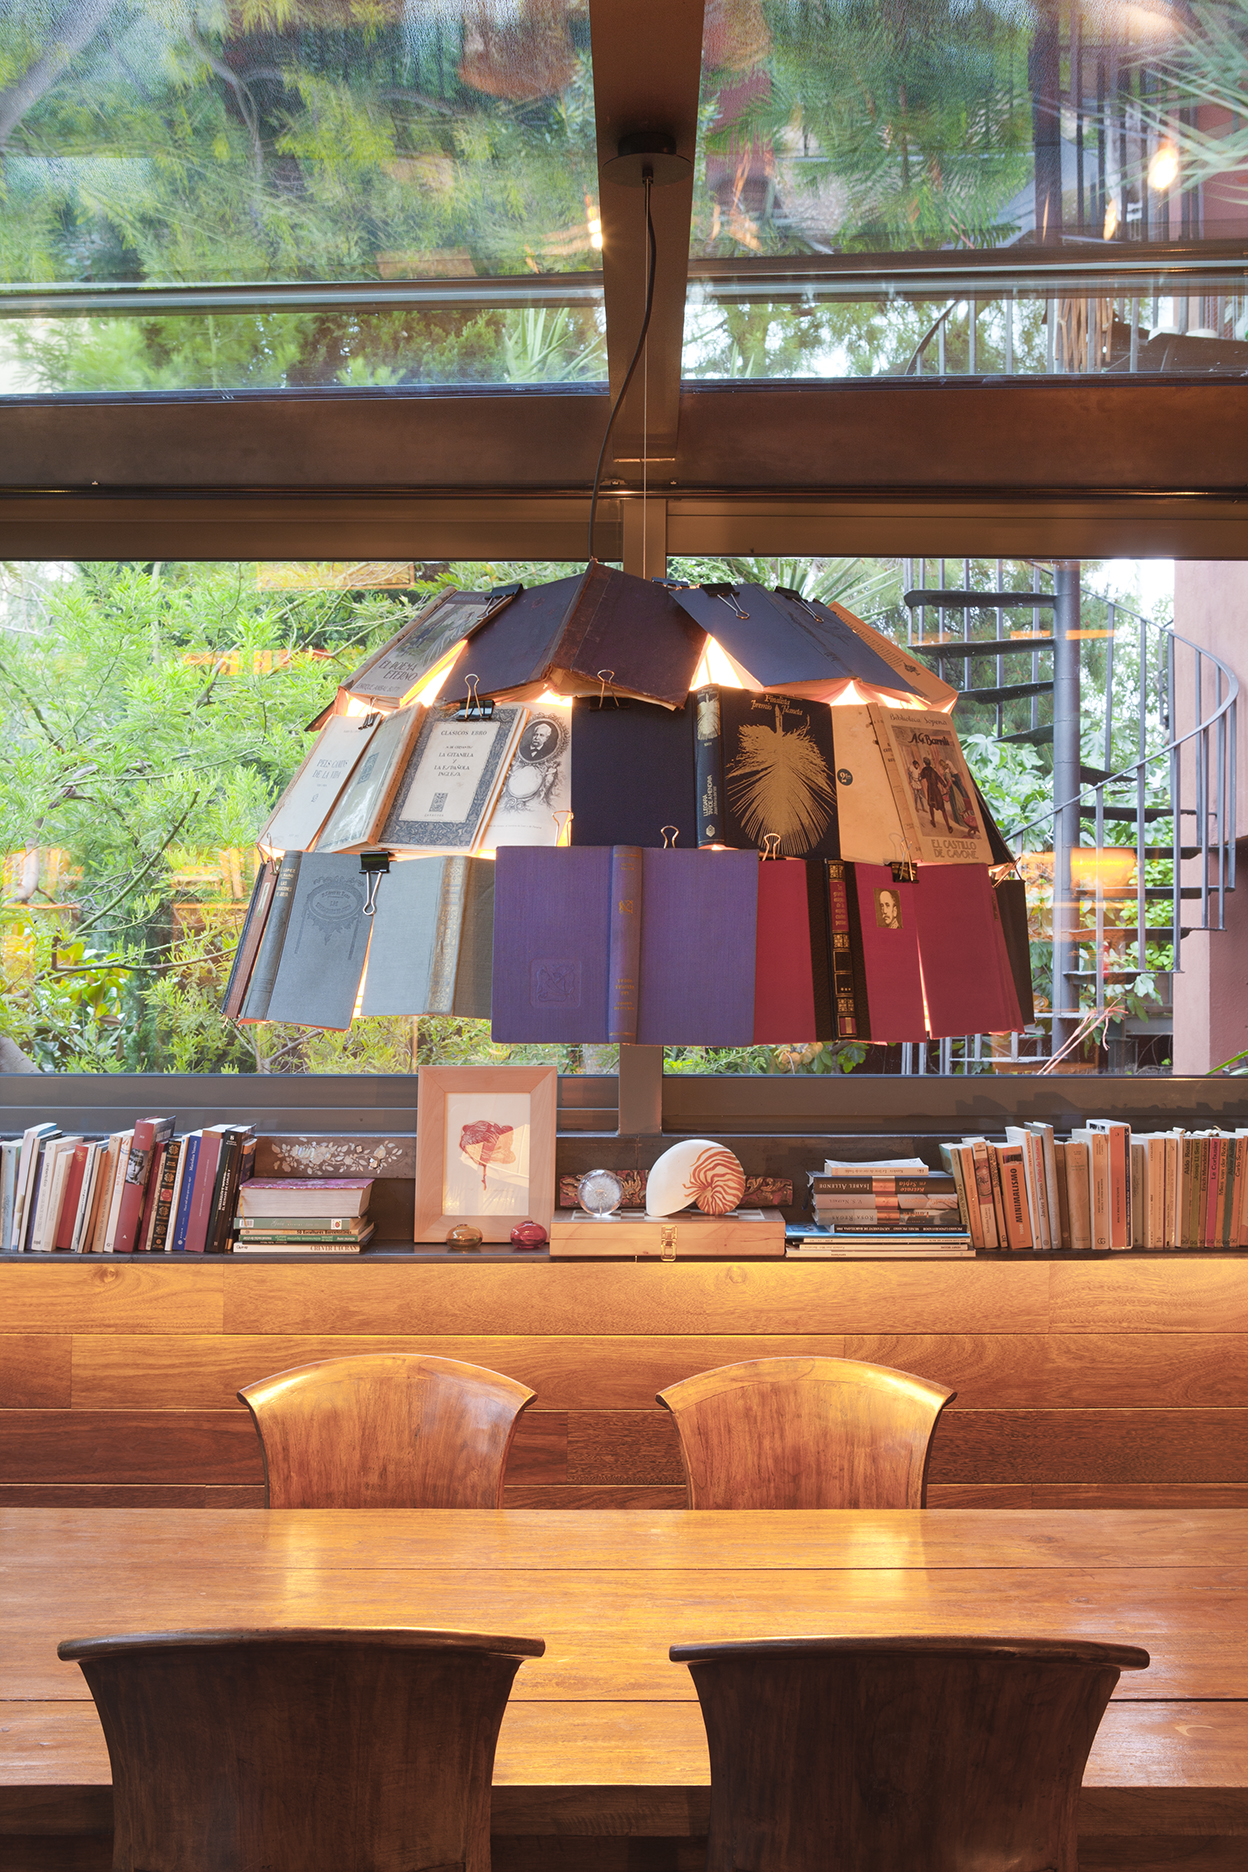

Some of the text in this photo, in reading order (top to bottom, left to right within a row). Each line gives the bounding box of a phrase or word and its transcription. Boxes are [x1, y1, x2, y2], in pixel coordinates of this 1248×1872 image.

[378, 660, 418, 671] EL POEMA
[383, 670, 418, 681] ETERNO
[890, 713, 947, 727] Biblioteca Sopena
[931, 839, 977, 850] EL CASTILLO
[933, 848, 945, 858] DE
[1032, 1139, 1046, 1218] Javier Tomeo Patio de butacas
[1210, 1171, 1216, 1180] Le
[818, 1182, 870, 1190] ISABEL ALLENDE
[898, 1179, 917, 1187] Sepia
[1009, 1167, 1023, 1223] MINIMALISMO
